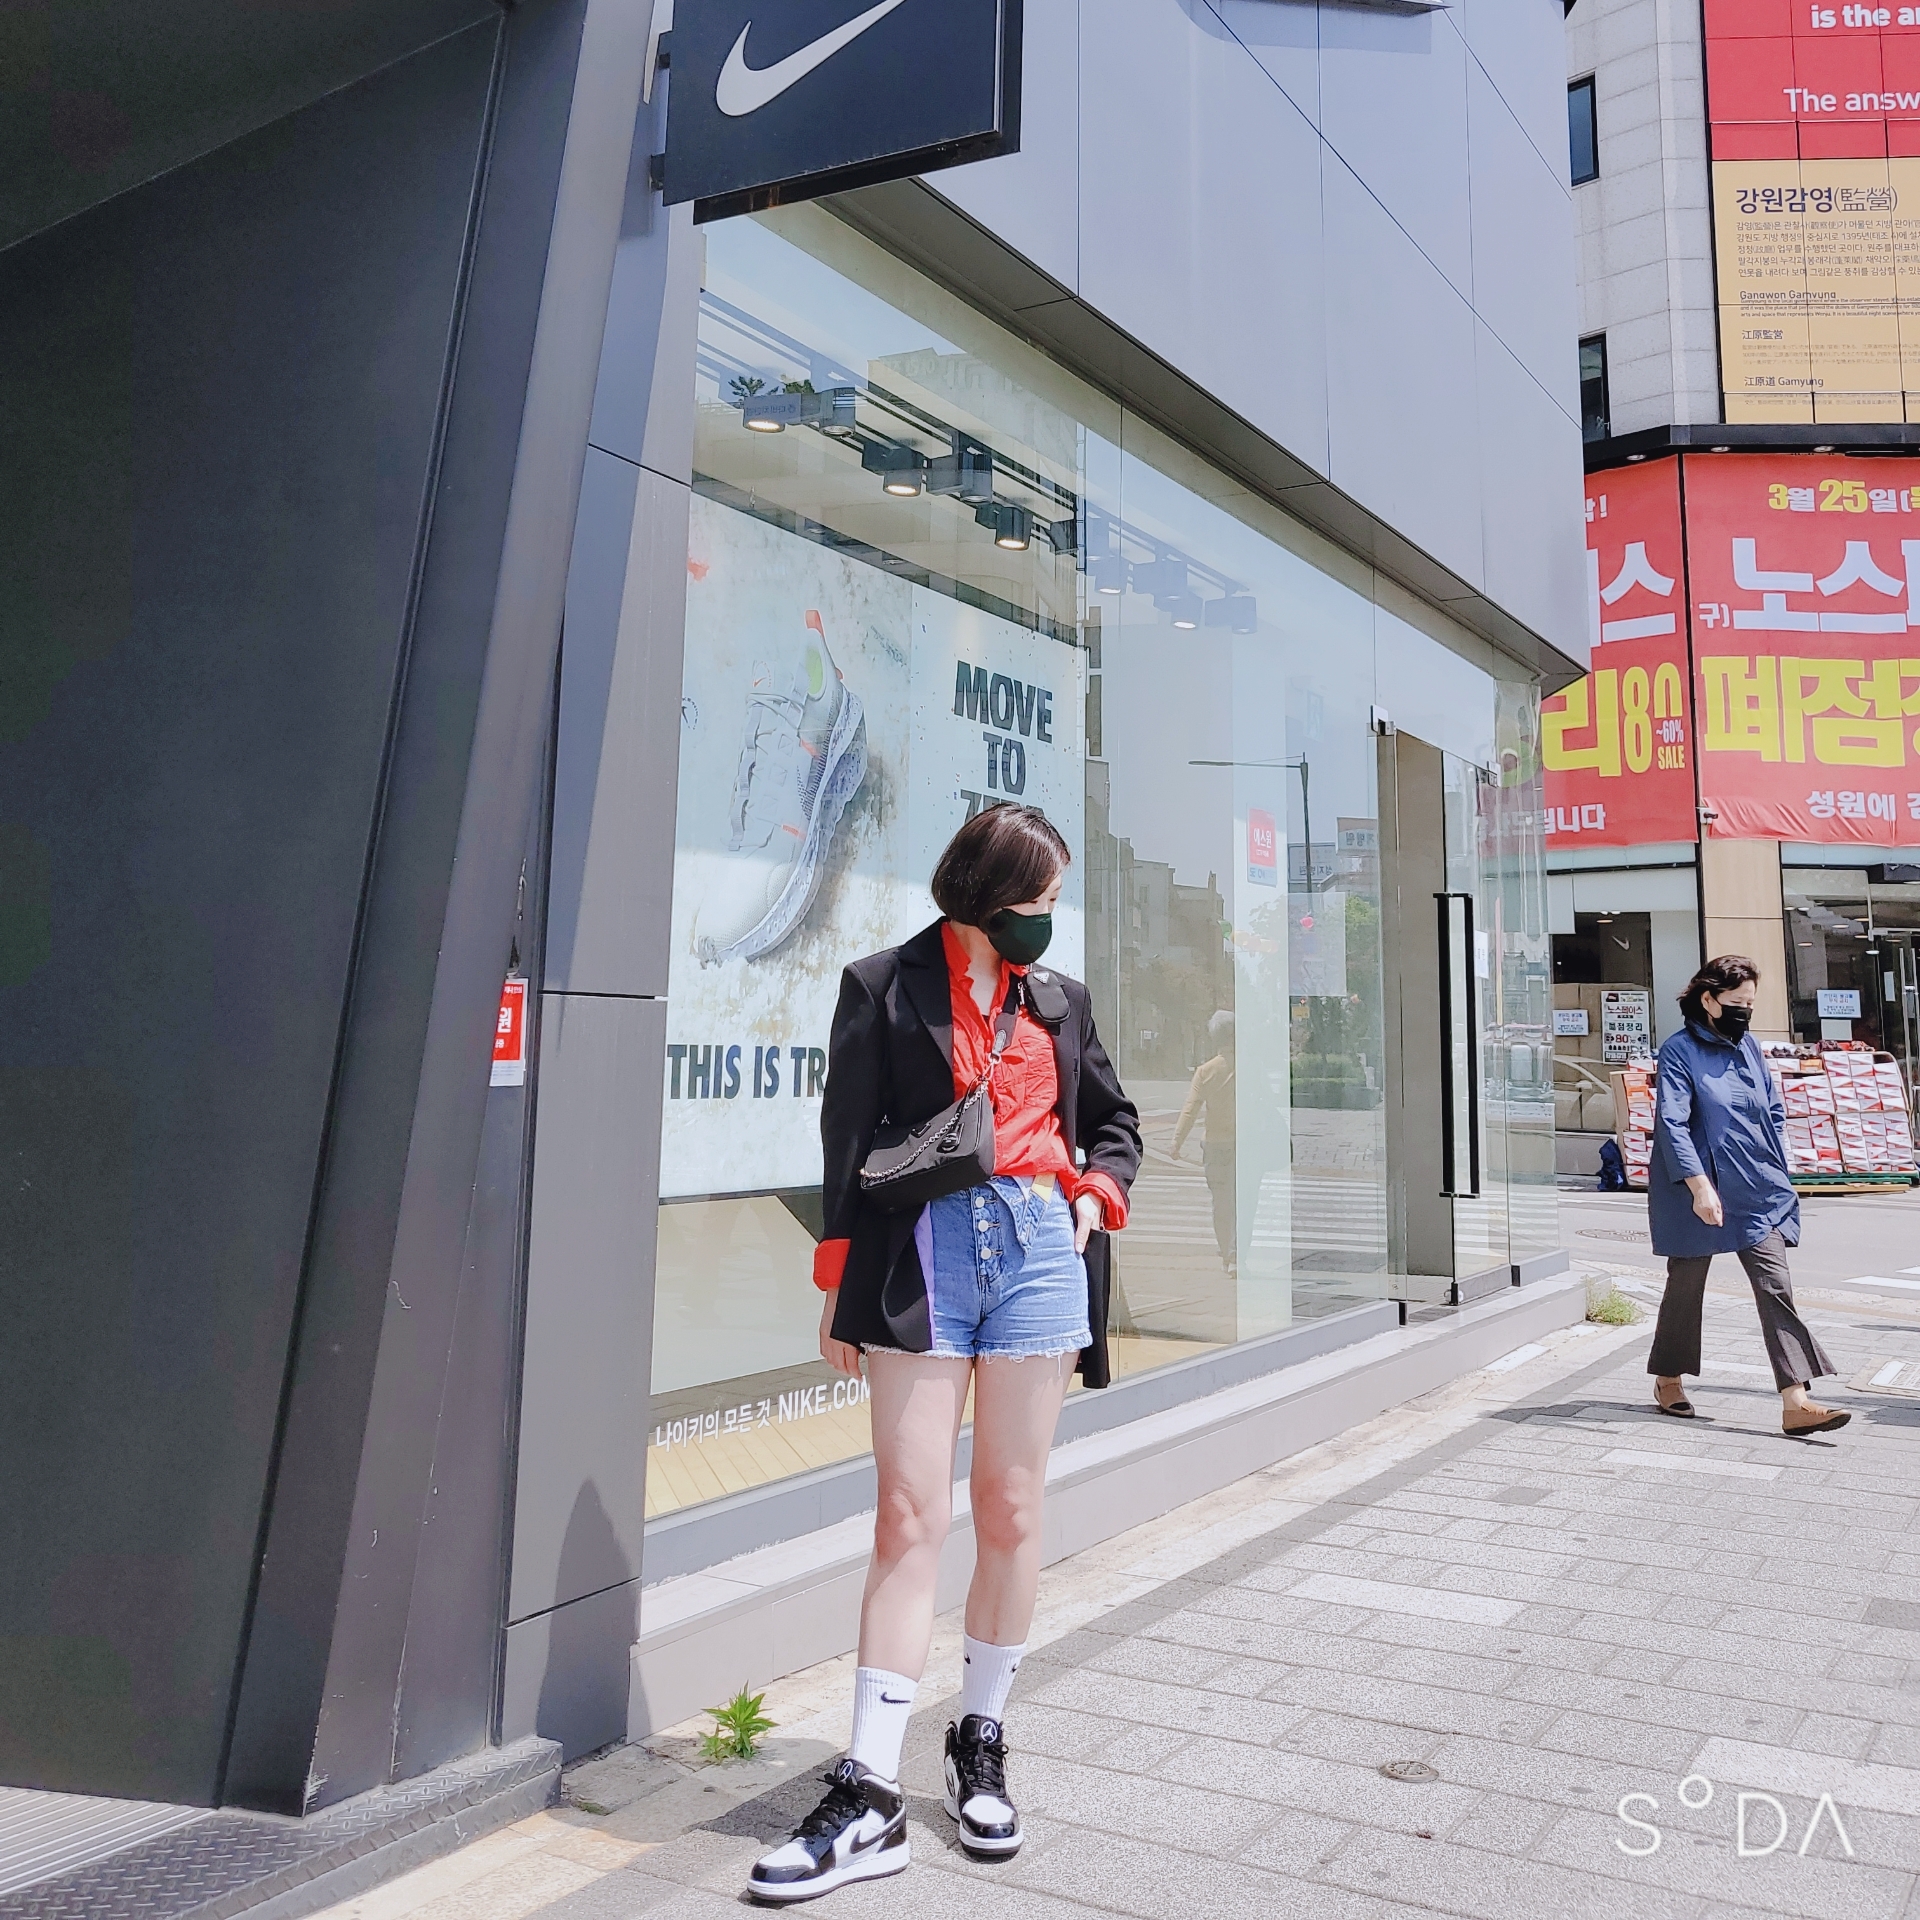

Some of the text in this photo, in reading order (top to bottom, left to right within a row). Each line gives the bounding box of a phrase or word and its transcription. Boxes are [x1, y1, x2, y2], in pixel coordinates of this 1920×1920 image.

[1811, 4, 1920, 28] is the a
[1783, 88, 1837, 113] The
[1737, 233, 1760, 242] 강원도
[1763, 233, 1778, 242] 지방
[1807, 232, 1839, 242] 중심지로
[1765, 268, 1789, 277] 내려다
[1744, 376, 1824, 388] 江原道 Gamyung
[1768, 483, 1815, 512] 3월
[1587, 541, 1676, 648] 스
[1732, 537, 1920, 633] 노스
[955, 660, 1053, 744] MOVE
[1700, 655, 1920, 767] 폐점
[983, 731, 1027, 795] TO
[1657, 745, 1686, 770] SALE
[1805, 790, 1896, 822] 성원에
[667, 1044, 741, 1100] THIS
[752, 1046, 779, 1099] IS
[655, 1410, 719, 1453] 나이키의
[722, 1403, 753, 1434] 모든
[756, 1398, 770, 1428] 것
